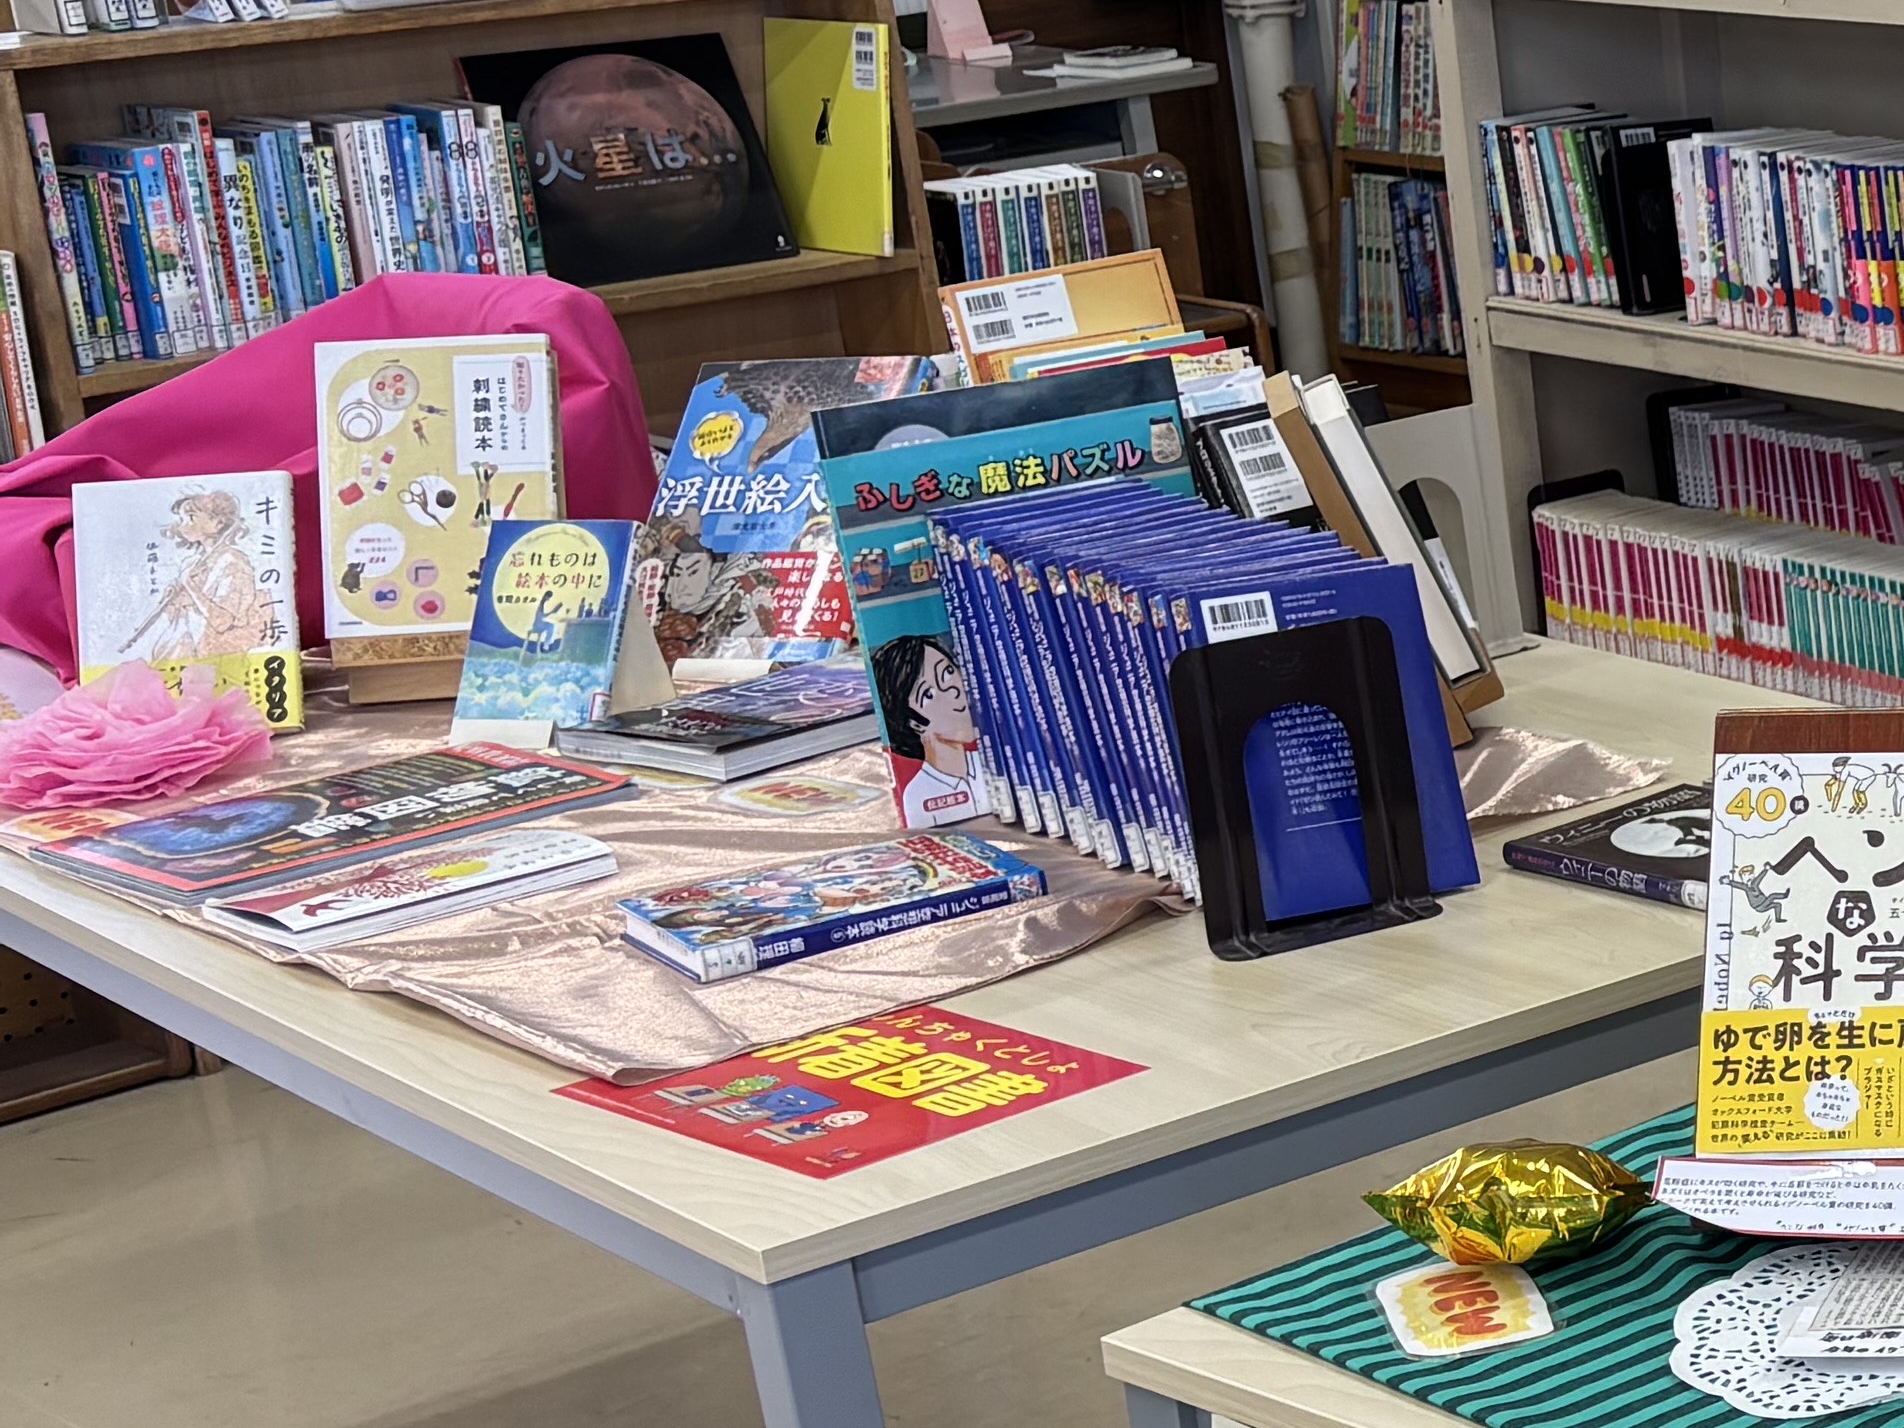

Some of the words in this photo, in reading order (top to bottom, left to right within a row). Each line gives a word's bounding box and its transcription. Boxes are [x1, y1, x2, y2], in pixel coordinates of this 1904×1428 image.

[855, 438, 1145, 513] ふしぎな魔法パズル
[255, 495, 289, 648] キミの一歩
[508, 551, 598, 569] 忘れものは
[514, 573, 603, 590] 絵本の中に
[1724, 787, 1787, 823] 40
[1836, 897, 1867, 929] な
[1712, 1054, 1853, 1088] 方法とは?
[1426, 1271, 1509, 1341] NEW
